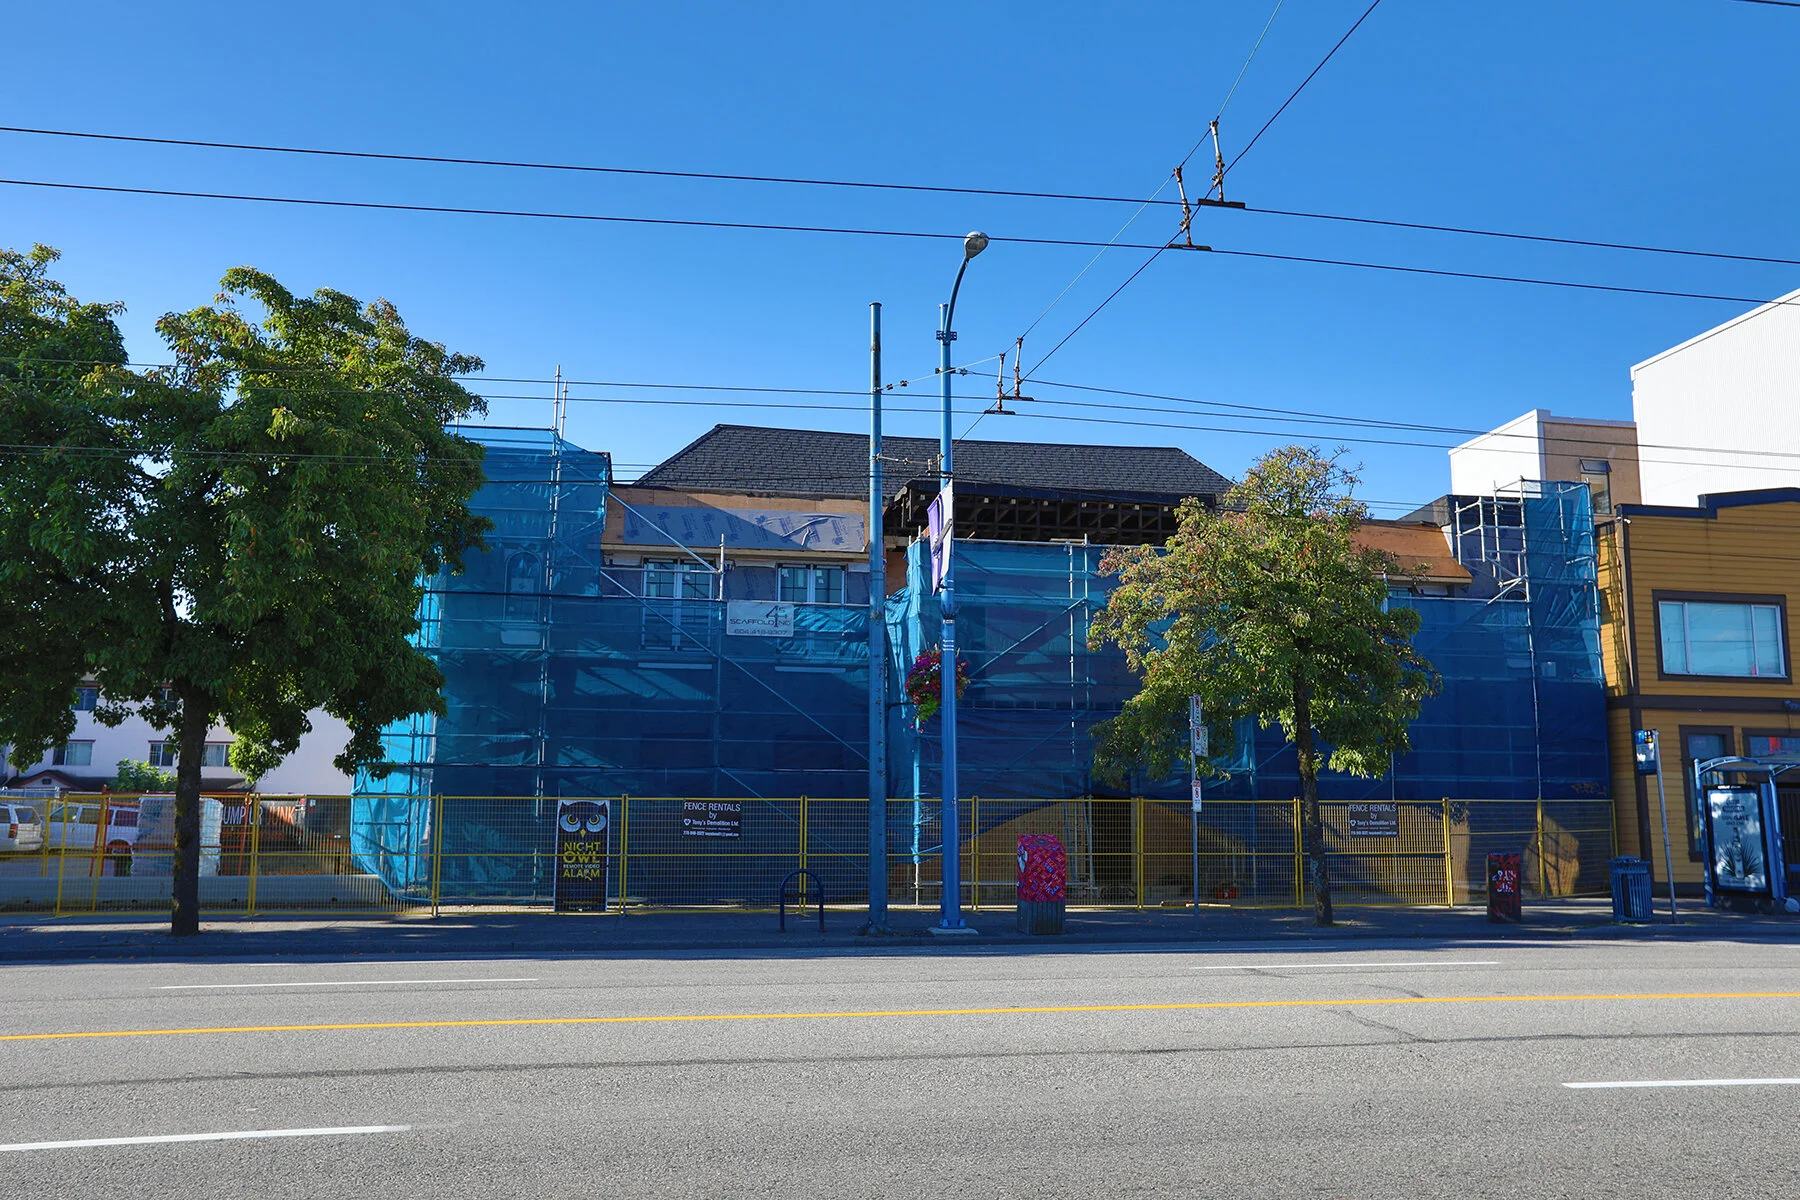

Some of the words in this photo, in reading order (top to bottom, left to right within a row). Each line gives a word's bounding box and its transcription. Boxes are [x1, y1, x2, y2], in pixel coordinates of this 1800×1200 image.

[684, 802, 707, 811] FENCE
[708, 803, 741, 812] RENTALS
[1348, 804, 1368, 812] FENCE
[1369, 804, 1397, 812] RENTALS
[221, 806, 246, 825] UMP
[267, 806, 296, 826] JUNK
[708, 811, 718, 820] by
[1370, 812, 1378, 820] by
[563, 842, 600, 851] NIGHT
[563, 851, 600, 864] OWL
[563, 869, 600, 879] ALARM
